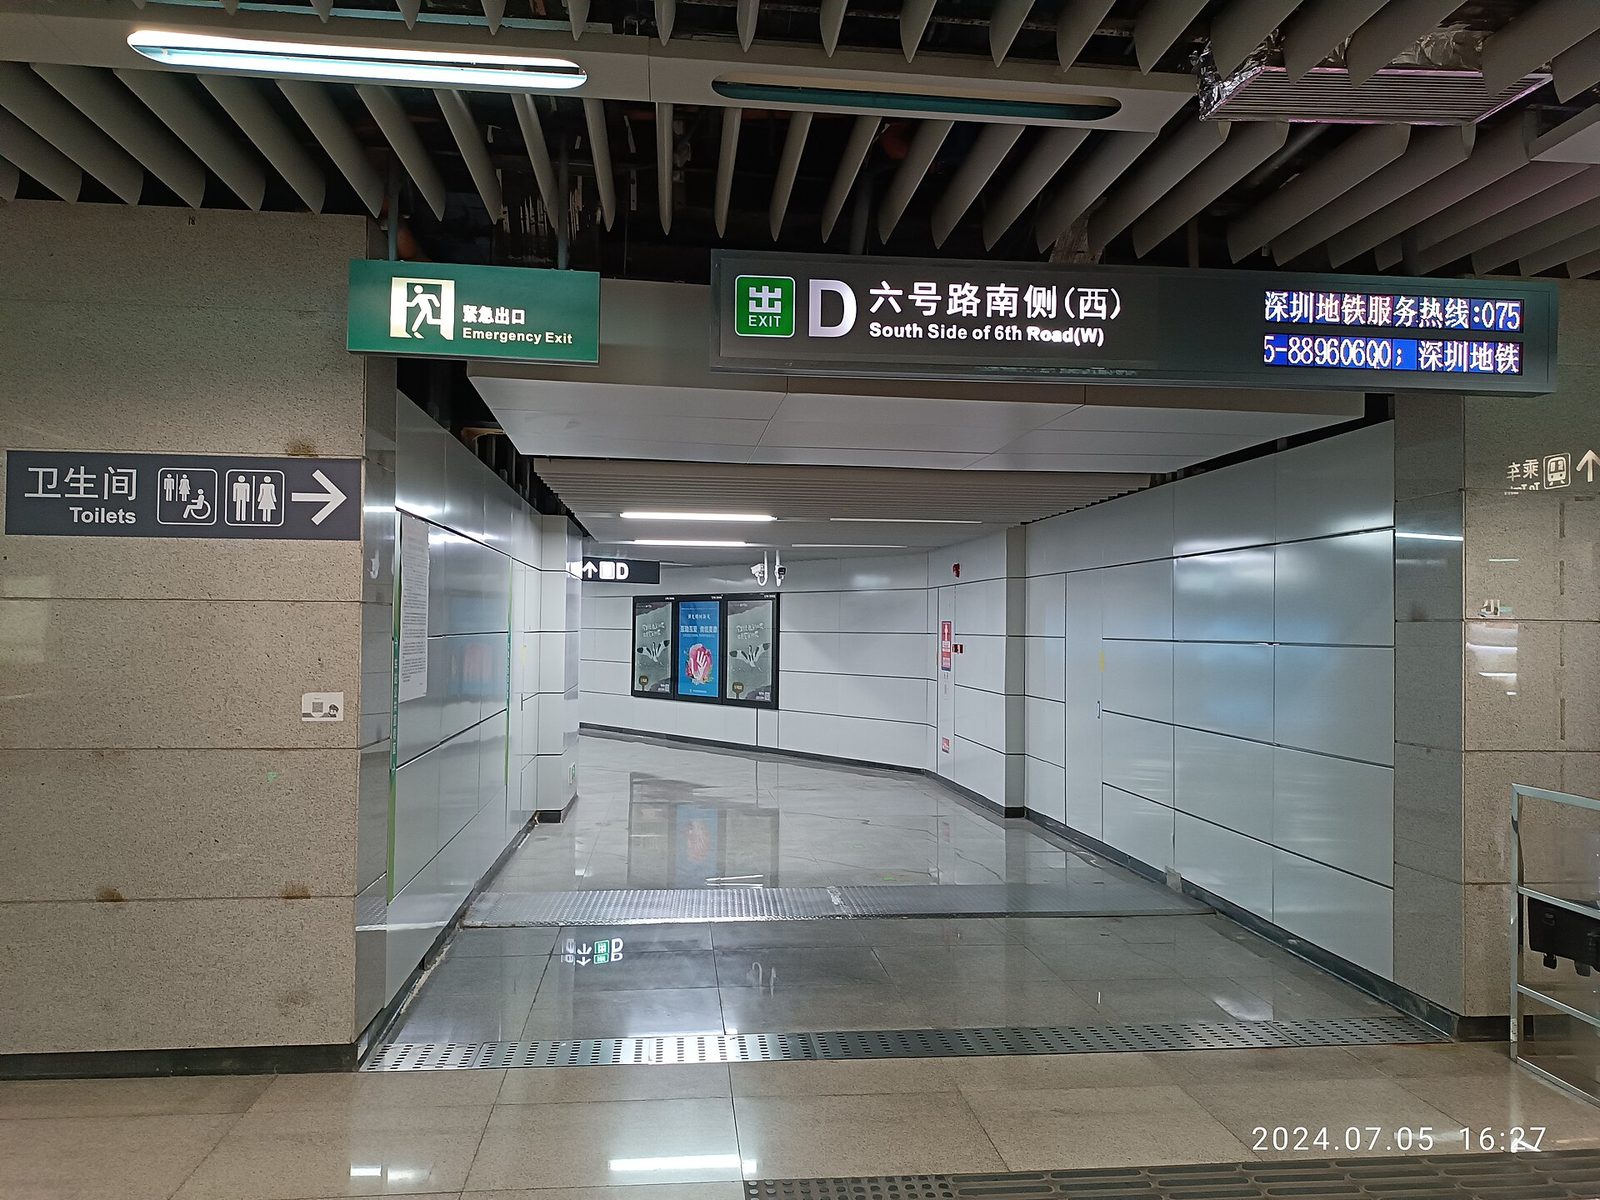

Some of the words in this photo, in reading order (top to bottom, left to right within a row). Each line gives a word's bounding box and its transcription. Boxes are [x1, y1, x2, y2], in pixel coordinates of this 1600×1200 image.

[749, 286, 781, 313] 出
[808, 279, 856, 337] D
[869, 281, 1121, 320] 六号路南侧(西)
[1264, 290, 1521, 330] 深圳地铁服务热线:075
[462, 304, 525, 325] 紧急出口
[748, 314, 782, 328] EXIT
[462, 328, 542, 345] Emergency
[545, 331, 573, 344] Exit
[869, 321, 923, 339] South
[927, 323, 968, 340] Side
[972, 324, 992, 340] of
[994, 325, 1022, 341] 6th
[1026, 326, 1104, 347] Road(W)
[24, 465, 137, 501] 卫生间
[69, 506, 137, 524] Toilets
[615, 562, 629, 580] D
